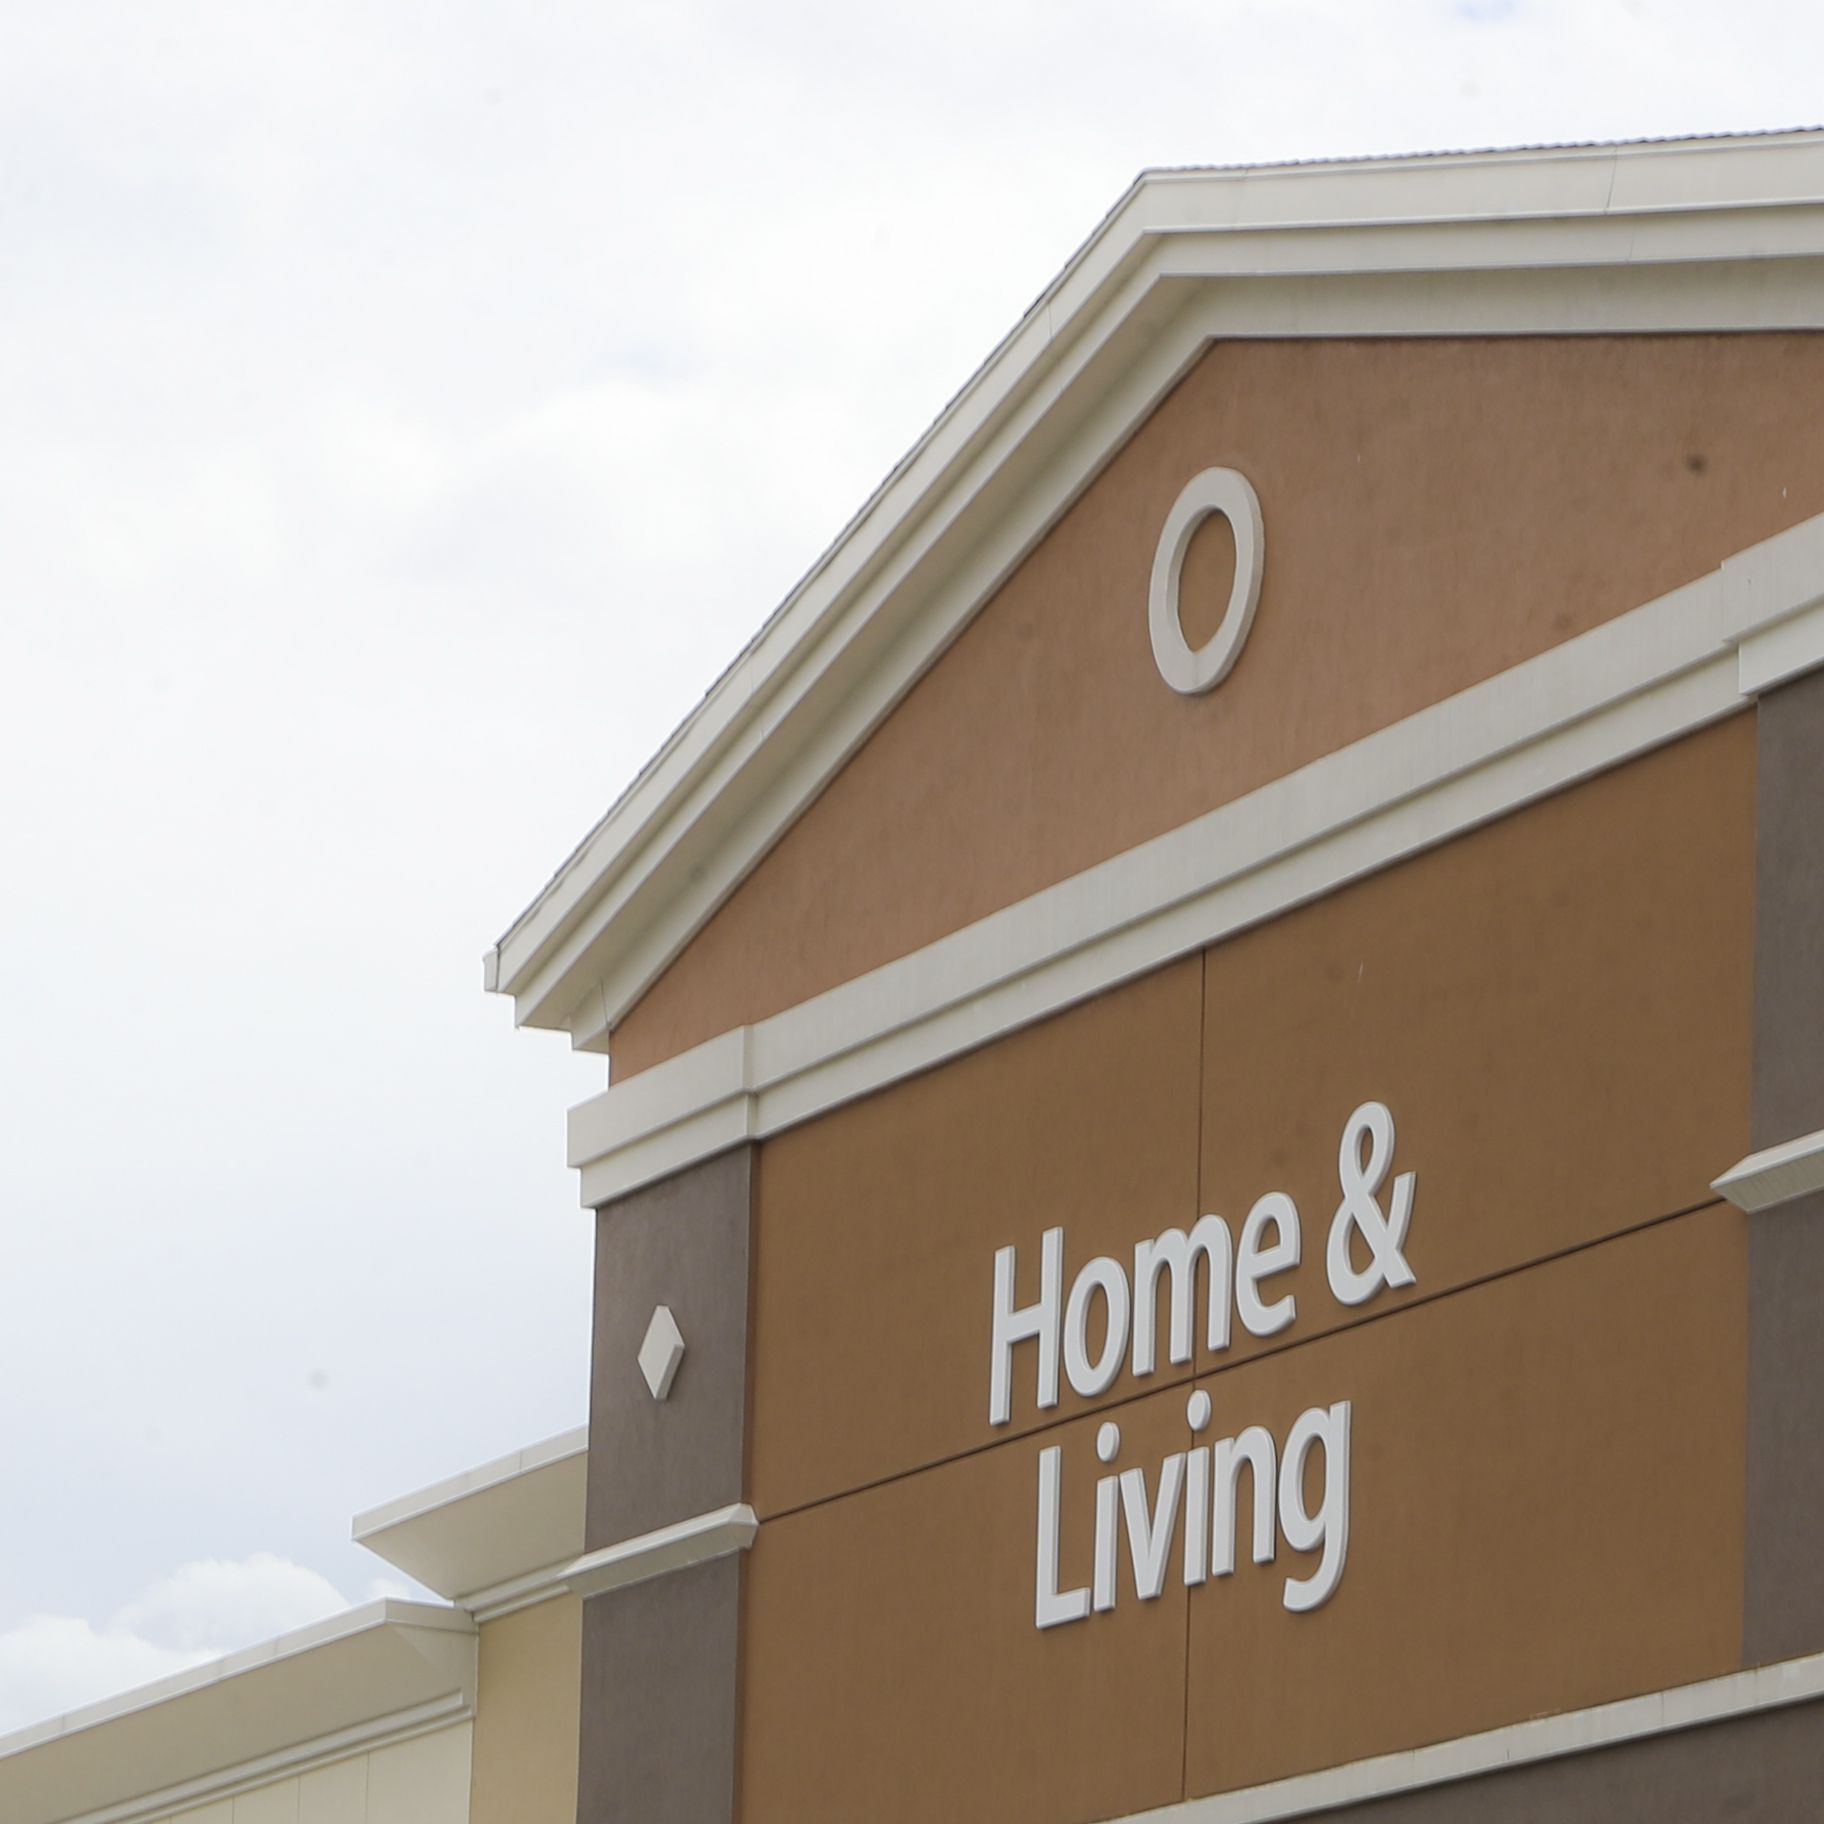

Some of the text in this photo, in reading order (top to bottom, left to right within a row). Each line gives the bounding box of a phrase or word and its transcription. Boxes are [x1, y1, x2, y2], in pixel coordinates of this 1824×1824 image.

[990, 1100, 1416, 1425] Home &
[1035, 1389, 1351, 1629] Living
